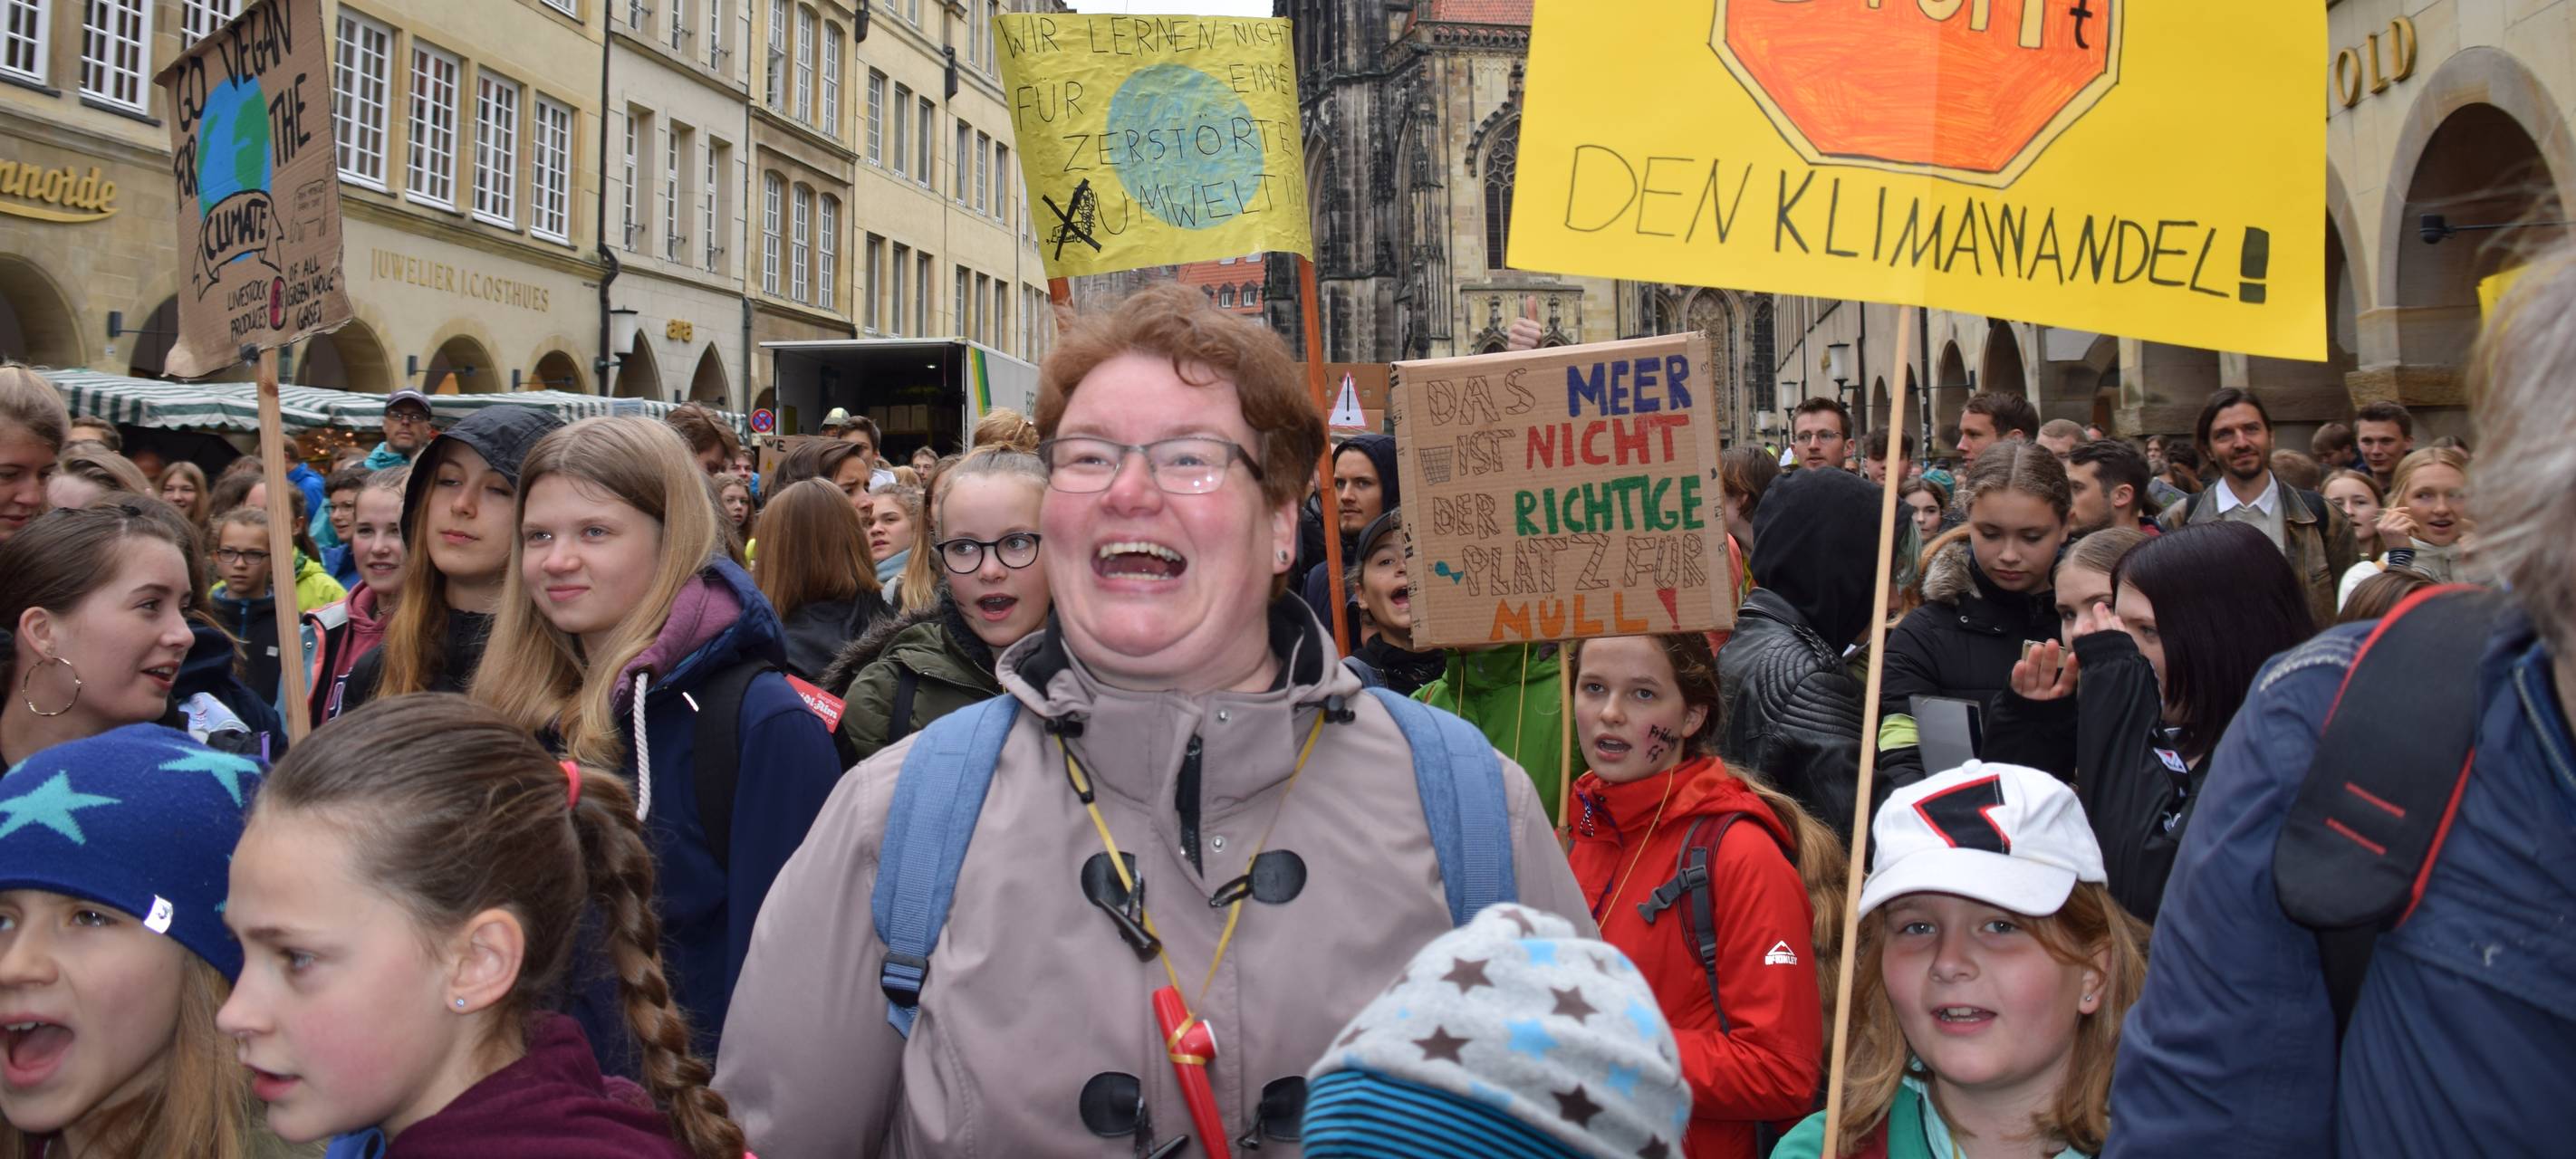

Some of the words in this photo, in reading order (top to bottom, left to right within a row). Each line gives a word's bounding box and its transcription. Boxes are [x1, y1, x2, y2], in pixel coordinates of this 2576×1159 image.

[177, 57, 207, 132] GO
[218, 0, 292, 91] VEGAN
[998, 16, 1060, 59] WIR
[1089, 16, 1216, 56] LERNEN
[1233, 22, 1290, 49] NICHT
[2334, 14, 2417, 109] OLD
[1017, 77, 1084, 131] FÜR
[1228, 63, 1290, 95] EINE
[174, 134, 198, 214] FOR
[269, 72, 311, 167] THE
[1063, 113, 1293, 172] ZERSTÖRTE
[205, 198, 268, 260] CLIMATE
[1564, 144, 1753, 244] DEN
[1774, 169, 2269, 303] KLIMAWANDEL!
[227, 280, 268, 311] LIVESTOCK
[289, 263, 298, 283] OF
[303, 254, 321, 277] ALL
[370, 248, 455, 292] JUWELIER
[230, 304, 268, 342] PRODUCES
[1427, 368, 1536, 426] DAS
[1566, 354, 1693, 418] MEER
[764, 439, 786, 452] WE
[1456, 428, 1516, 476] IST
[1526, 414, 1690, 470] NICHT
[1433, 493, 1501, 539] DER
[1514, 474, 1705, 536] RICHTIGE
[1462, 532, 1610, 597] PLATZ
[1623, 533, 1706, 589] FÜR
